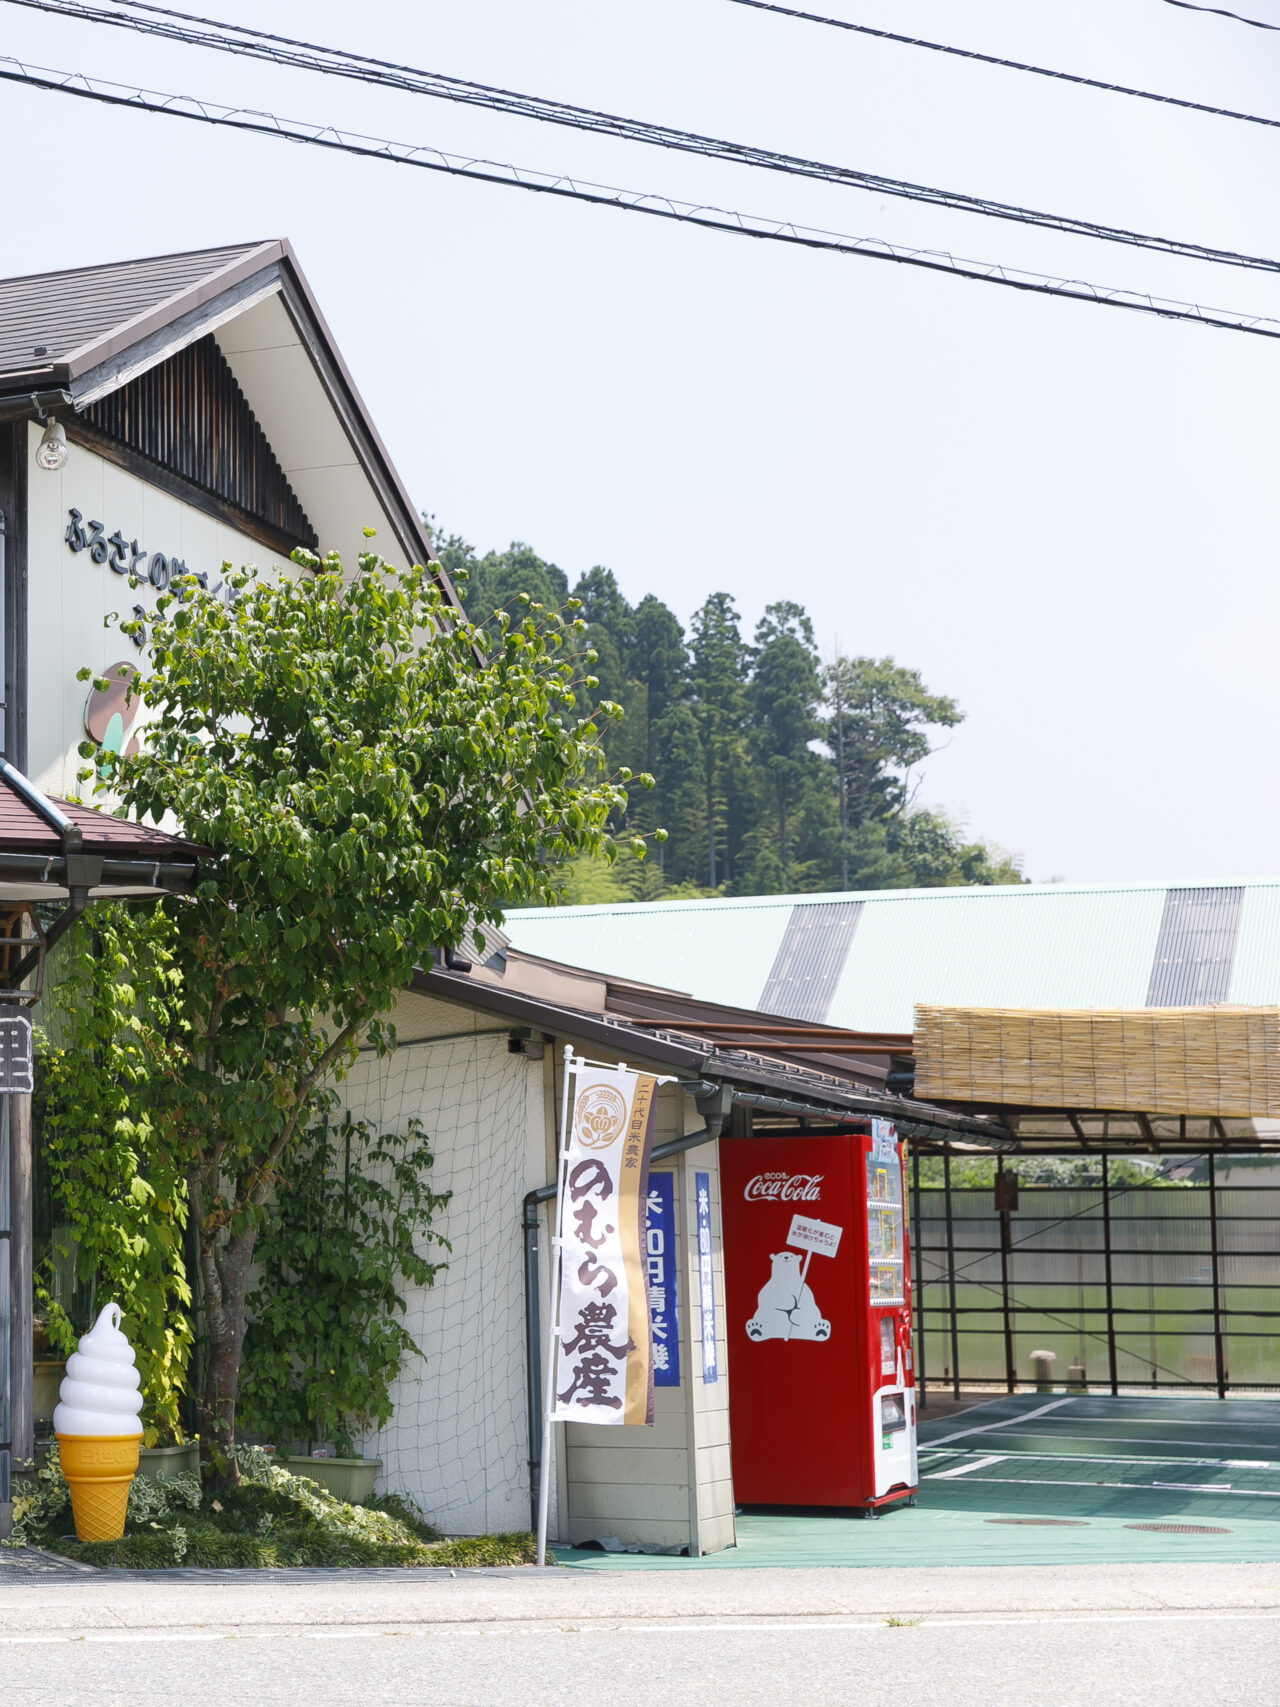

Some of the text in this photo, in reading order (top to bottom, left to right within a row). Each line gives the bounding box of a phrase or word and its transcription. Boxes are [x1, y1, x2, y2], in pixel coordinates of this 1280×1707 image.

[624, 1084, 647, 1170] 二十代目米農家
[744, 1174, 825, 1201] Coca-Cola
[556, 1158, 636, 1409] のむら農産
